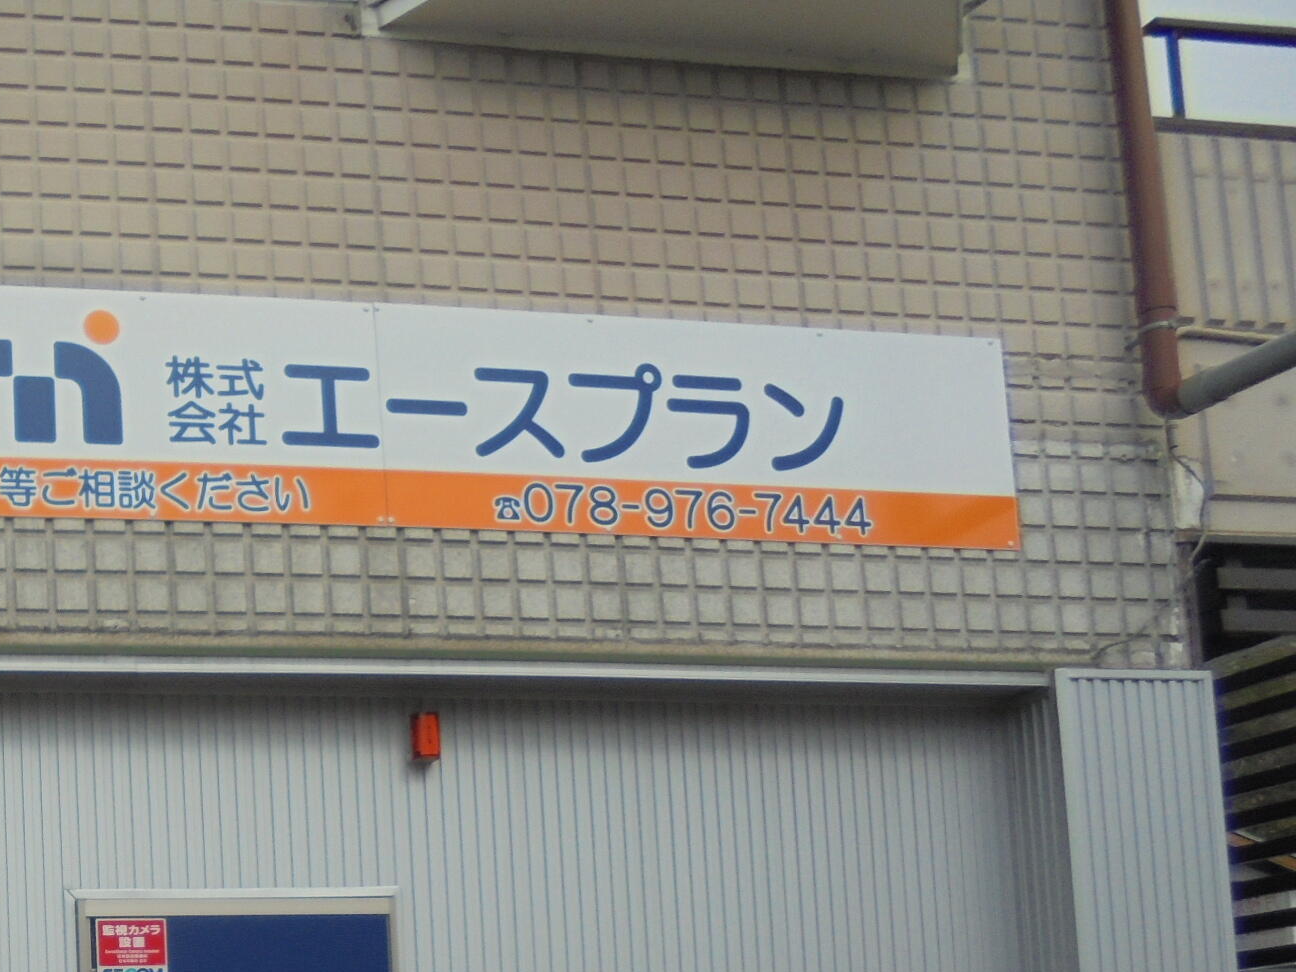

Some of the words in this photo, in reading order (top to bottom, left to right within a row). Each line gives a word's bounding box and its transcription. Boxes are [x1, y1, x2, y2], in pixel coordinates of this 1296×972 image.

[281, 362, 845, 473] エースプラン
[522, 480, 873, 537] 078-976-7444
